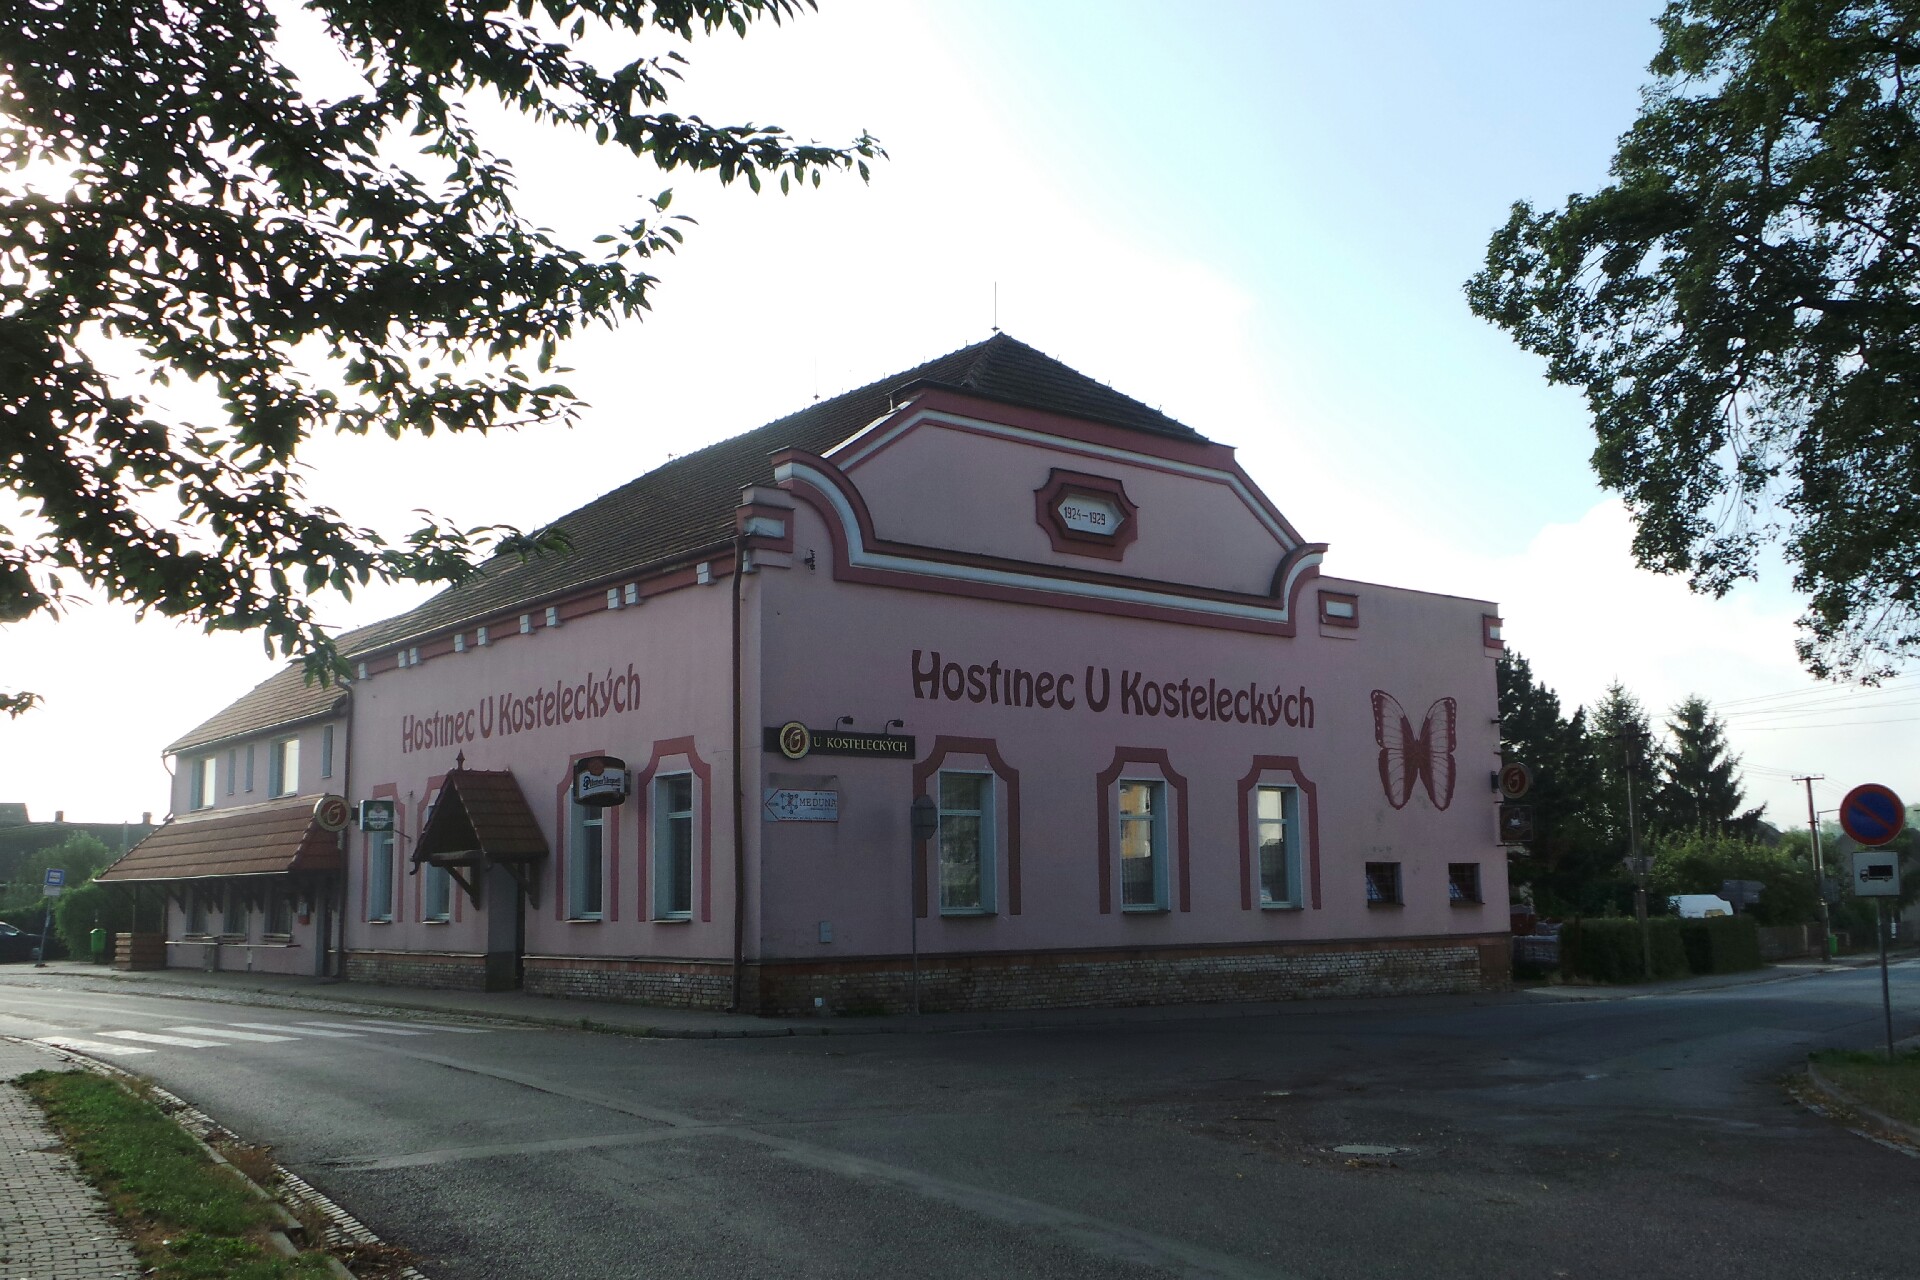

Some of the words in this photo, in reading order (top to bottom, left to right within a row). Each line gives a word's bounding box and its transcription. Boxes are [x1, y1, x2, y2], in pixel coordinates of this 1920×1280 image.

[402, 708, 475, 754] Hostinec
[479, 695, 494, 739] U
[499, 663, 642, 736] Kosteleckých
[911, 649, 1076, 711] Hostinec
[1085, 665, 1111, 713] U
[1120, 669, 1315, 729] Kosteleckých
[813, 736, 822, 748] U
[826, 737, 908, 752] KOSTELECKÝCH
[799, 797, 837, 808] MEDUNA
